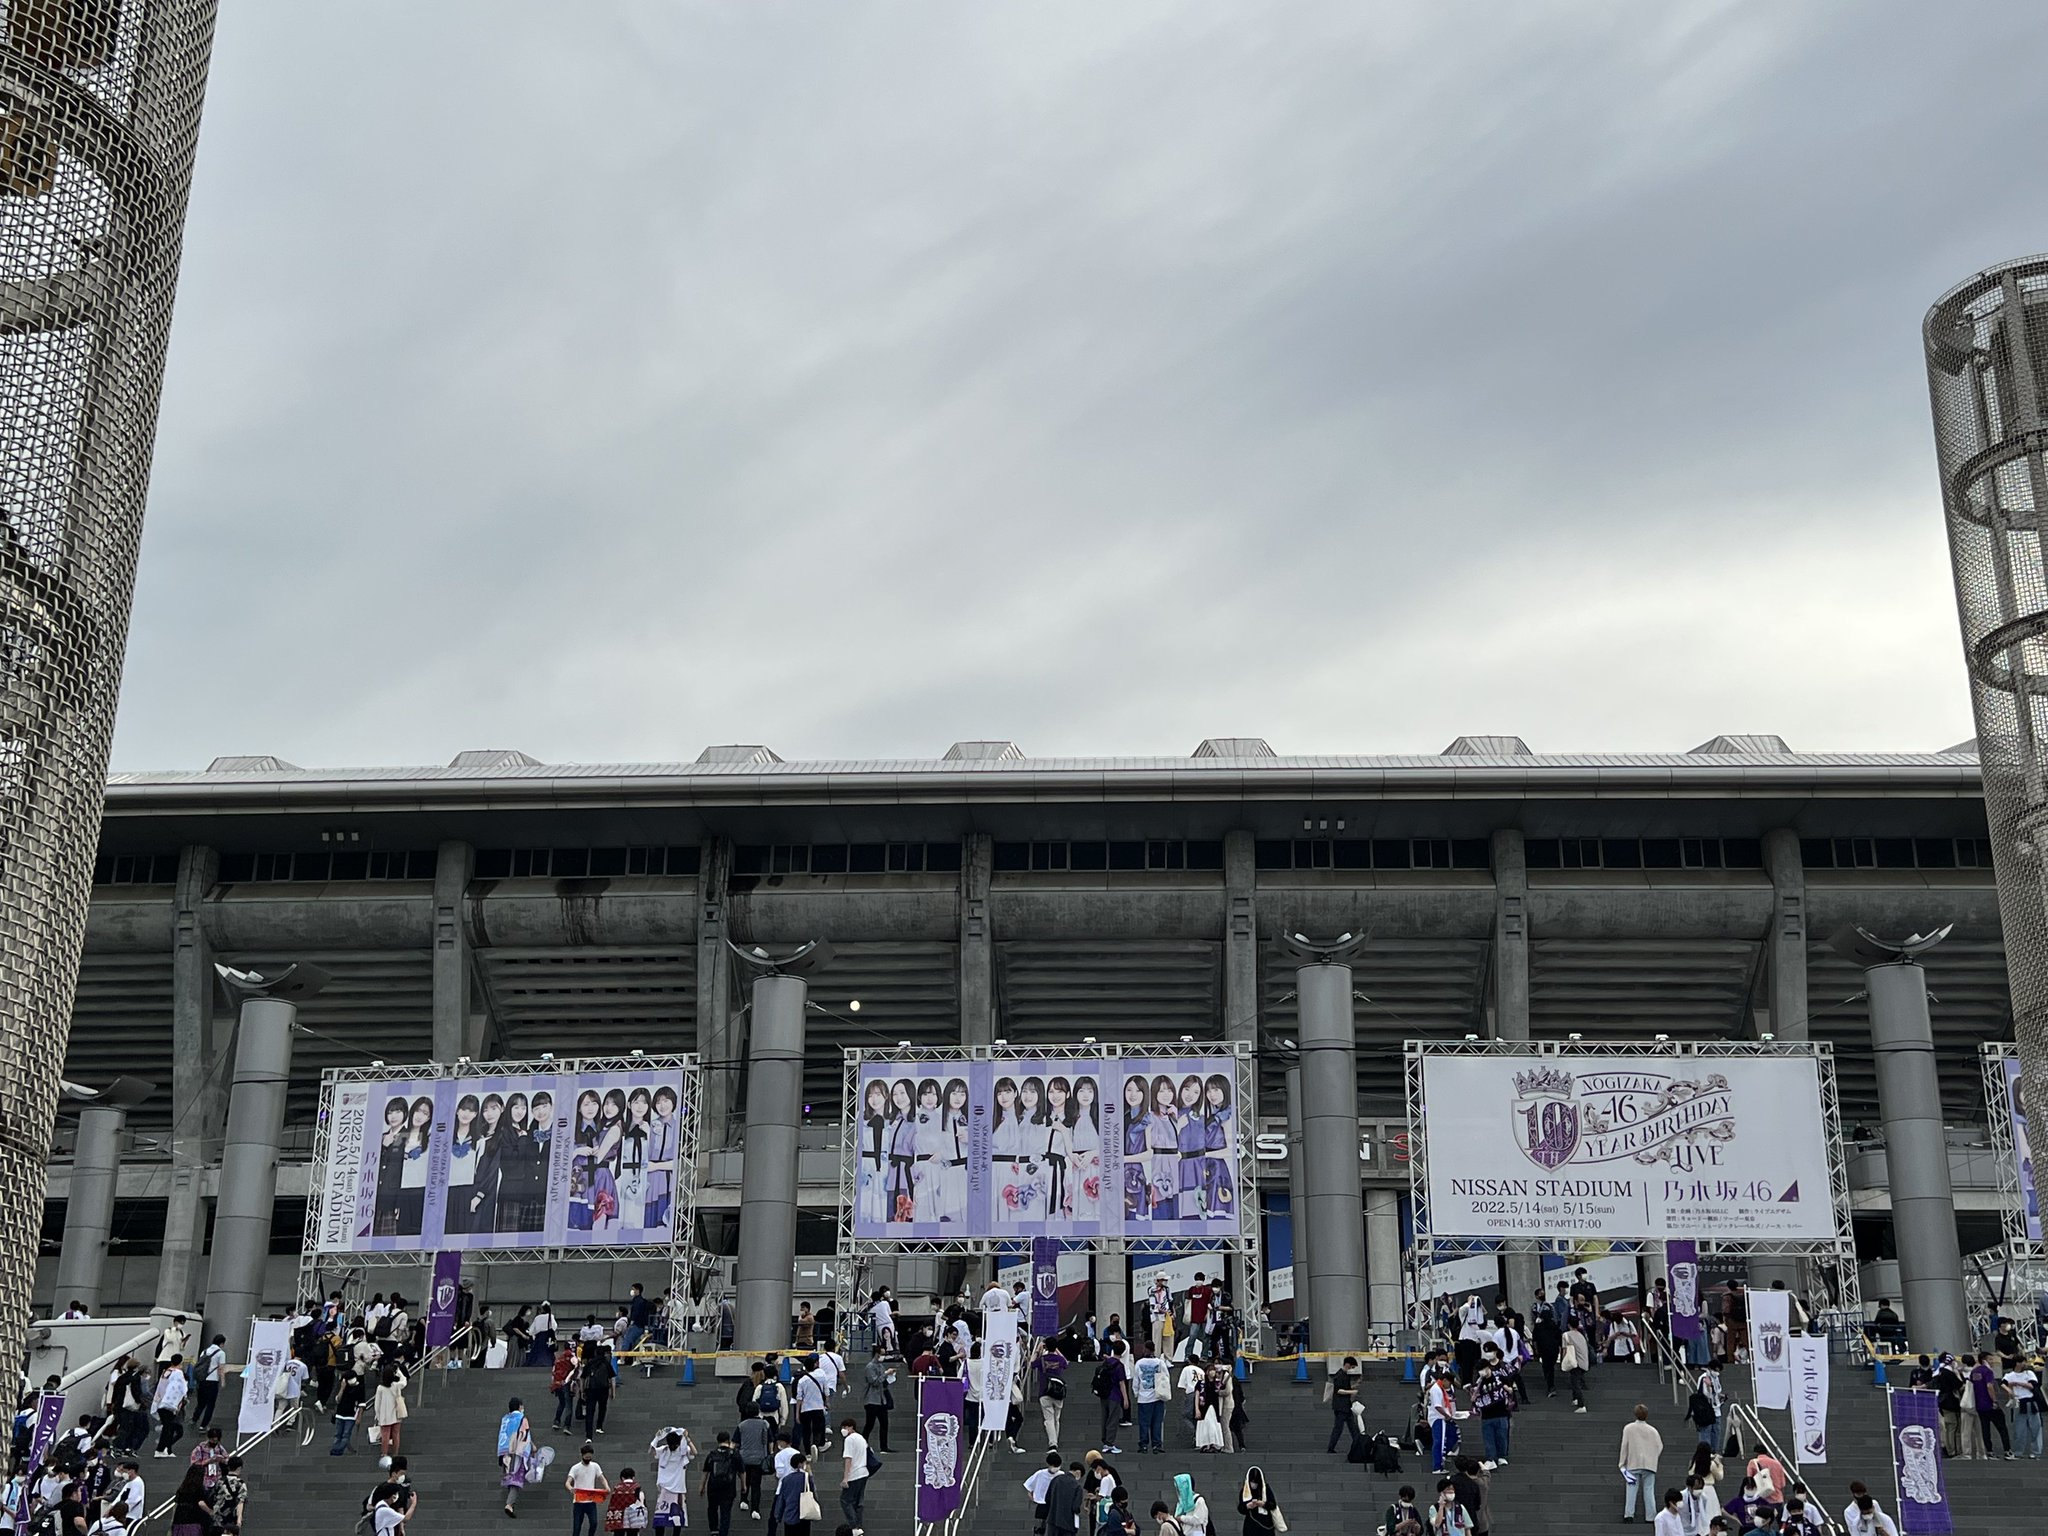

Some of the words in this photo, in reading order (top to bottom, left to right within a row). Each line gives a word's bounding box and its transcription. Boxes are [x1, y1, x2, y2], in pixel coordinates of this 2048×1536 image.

[1583, 1076, 1662, 1092] NOGIZAKA
[1601, 1094, 1638, 1124] 46
[335, 1109, 352, 1165] NISSAN
[1517, 1101, 1577, 1150] 10
[1585, 1133, 1636, 1157] YEAR
[1640, 1096, 1732, 1145] BIRTHDAY
[346, 1109, 365, 1193] 2022.5/14(sat)
[1670, 1143, 1724, 1174] LIVE
[1451, 1179, 1528, 1196] NISSAN
[1535, 1180, 1632, 1197] STADIUM
[1663, 1180, 1772, 1201] 乃木坂46
[326, 1171, 346, 1244] STADIUM
[1471, 1201, 1559, 1215] 2022.5/14(sat)
[1563, 1202, 1615, 1215] 5/15(sun)
